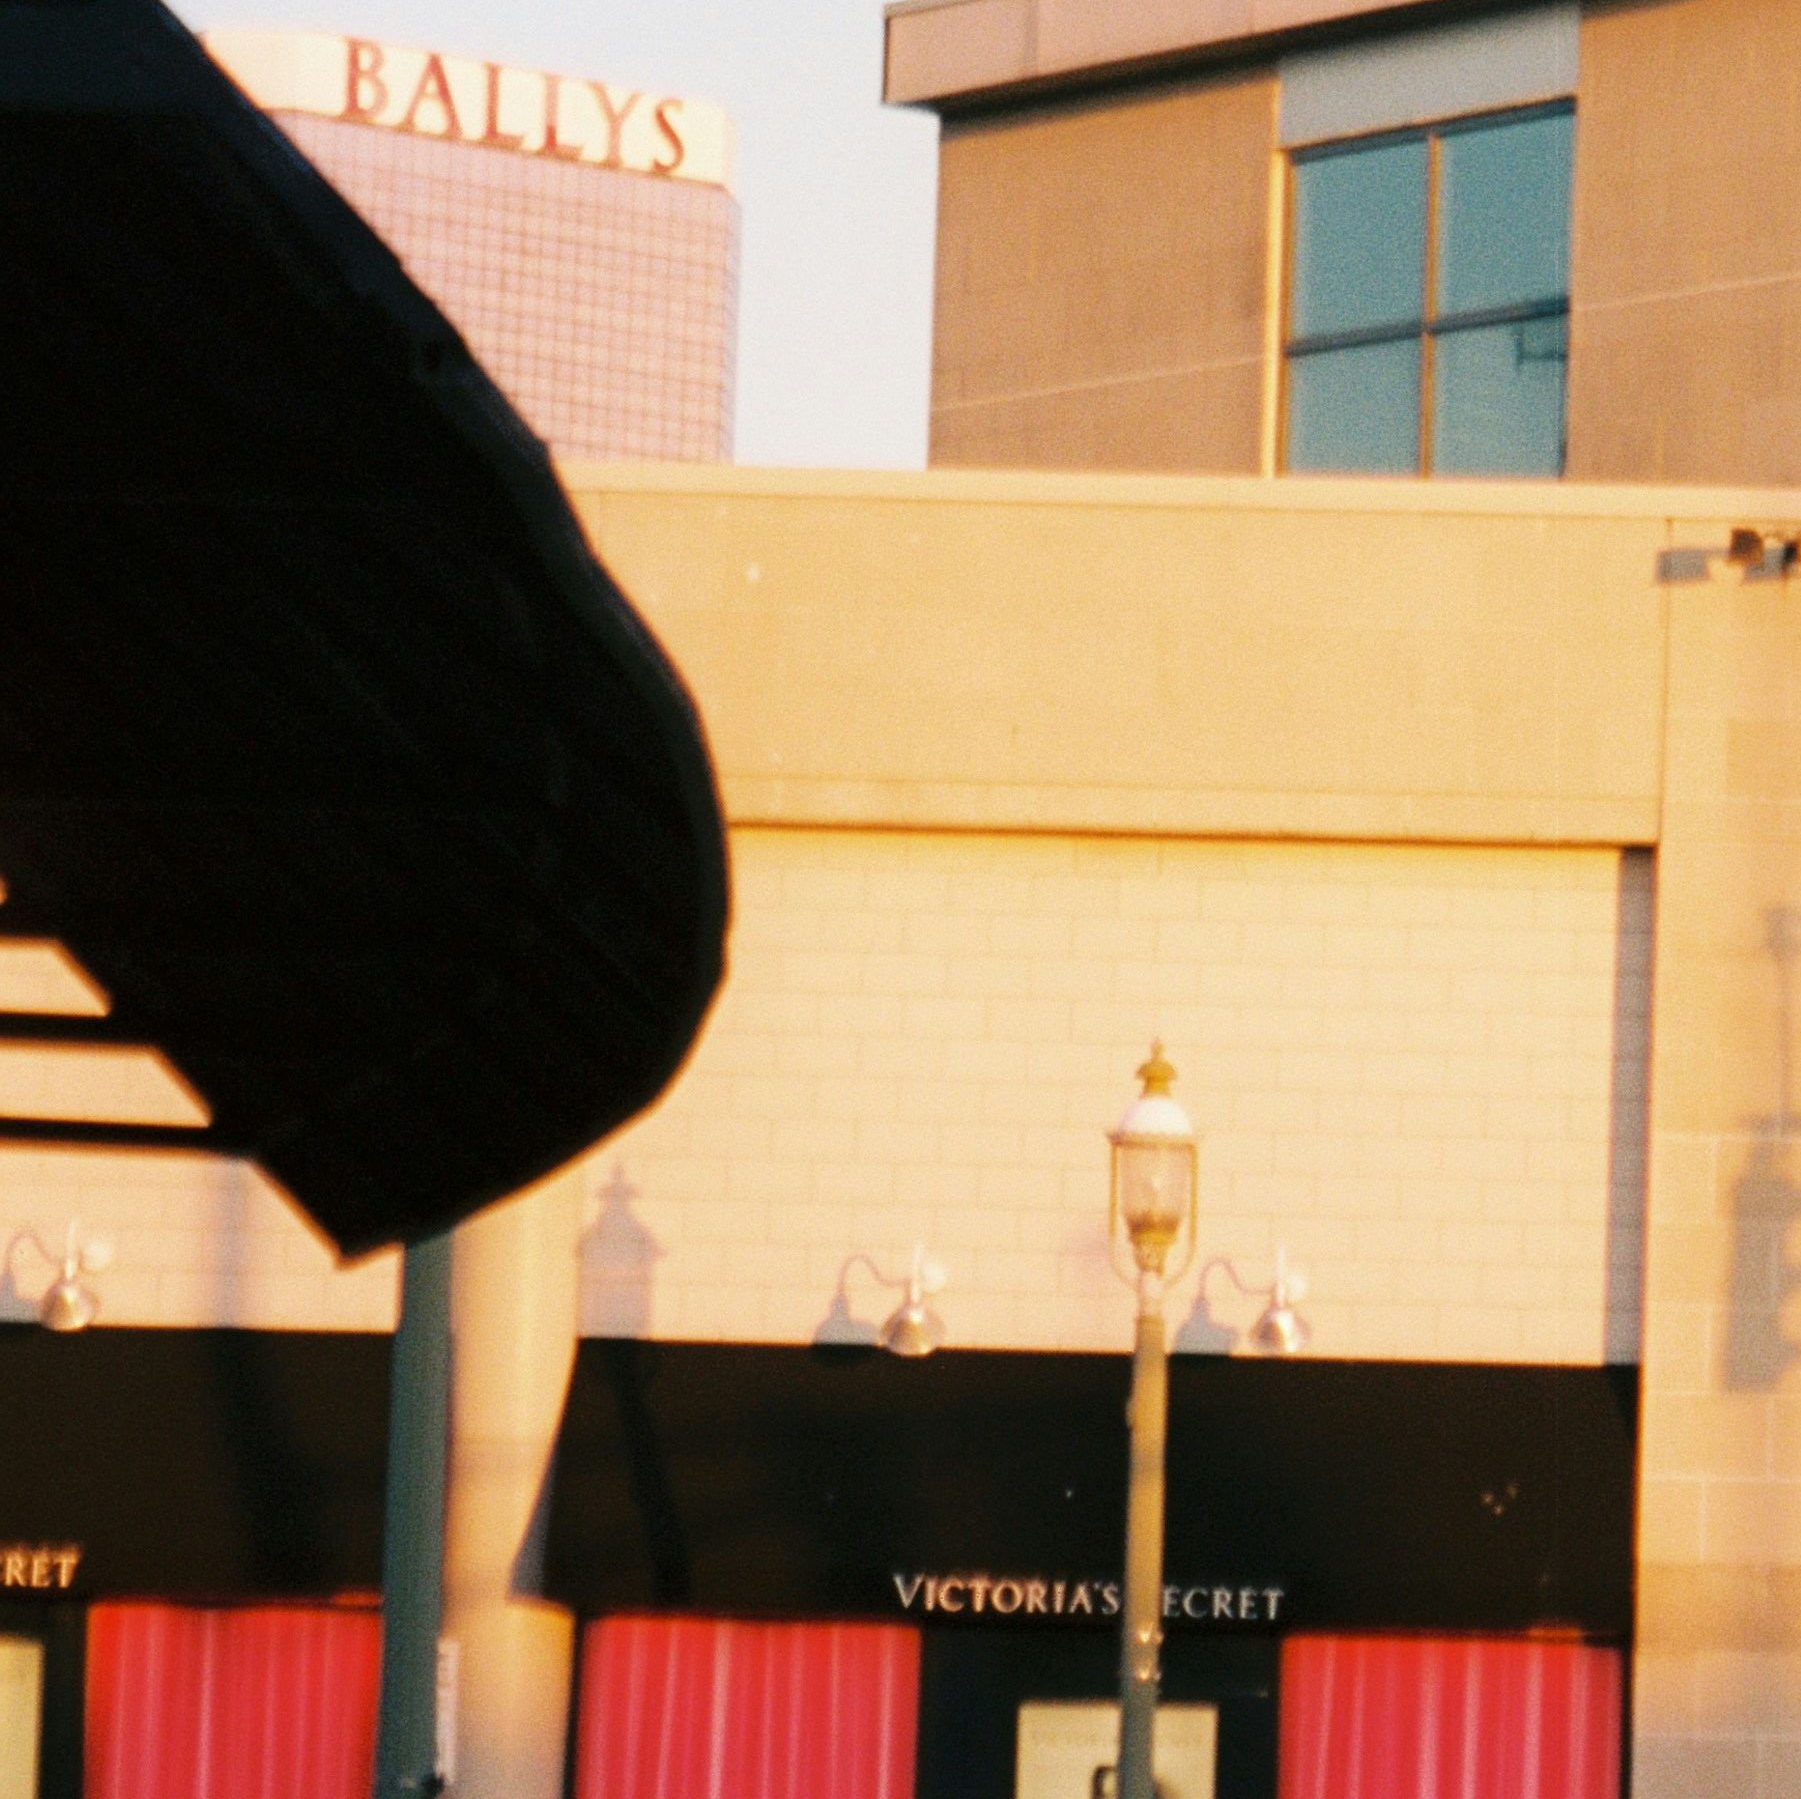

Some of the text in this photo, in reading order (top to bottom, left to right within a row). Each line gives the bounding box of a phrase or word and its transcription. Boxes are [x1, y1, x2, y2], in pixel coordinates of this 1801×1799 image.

[338, 37, 686, 177] BALLYS
[893, 1572, 1284, 1621] VICTORIA'S ECRET
